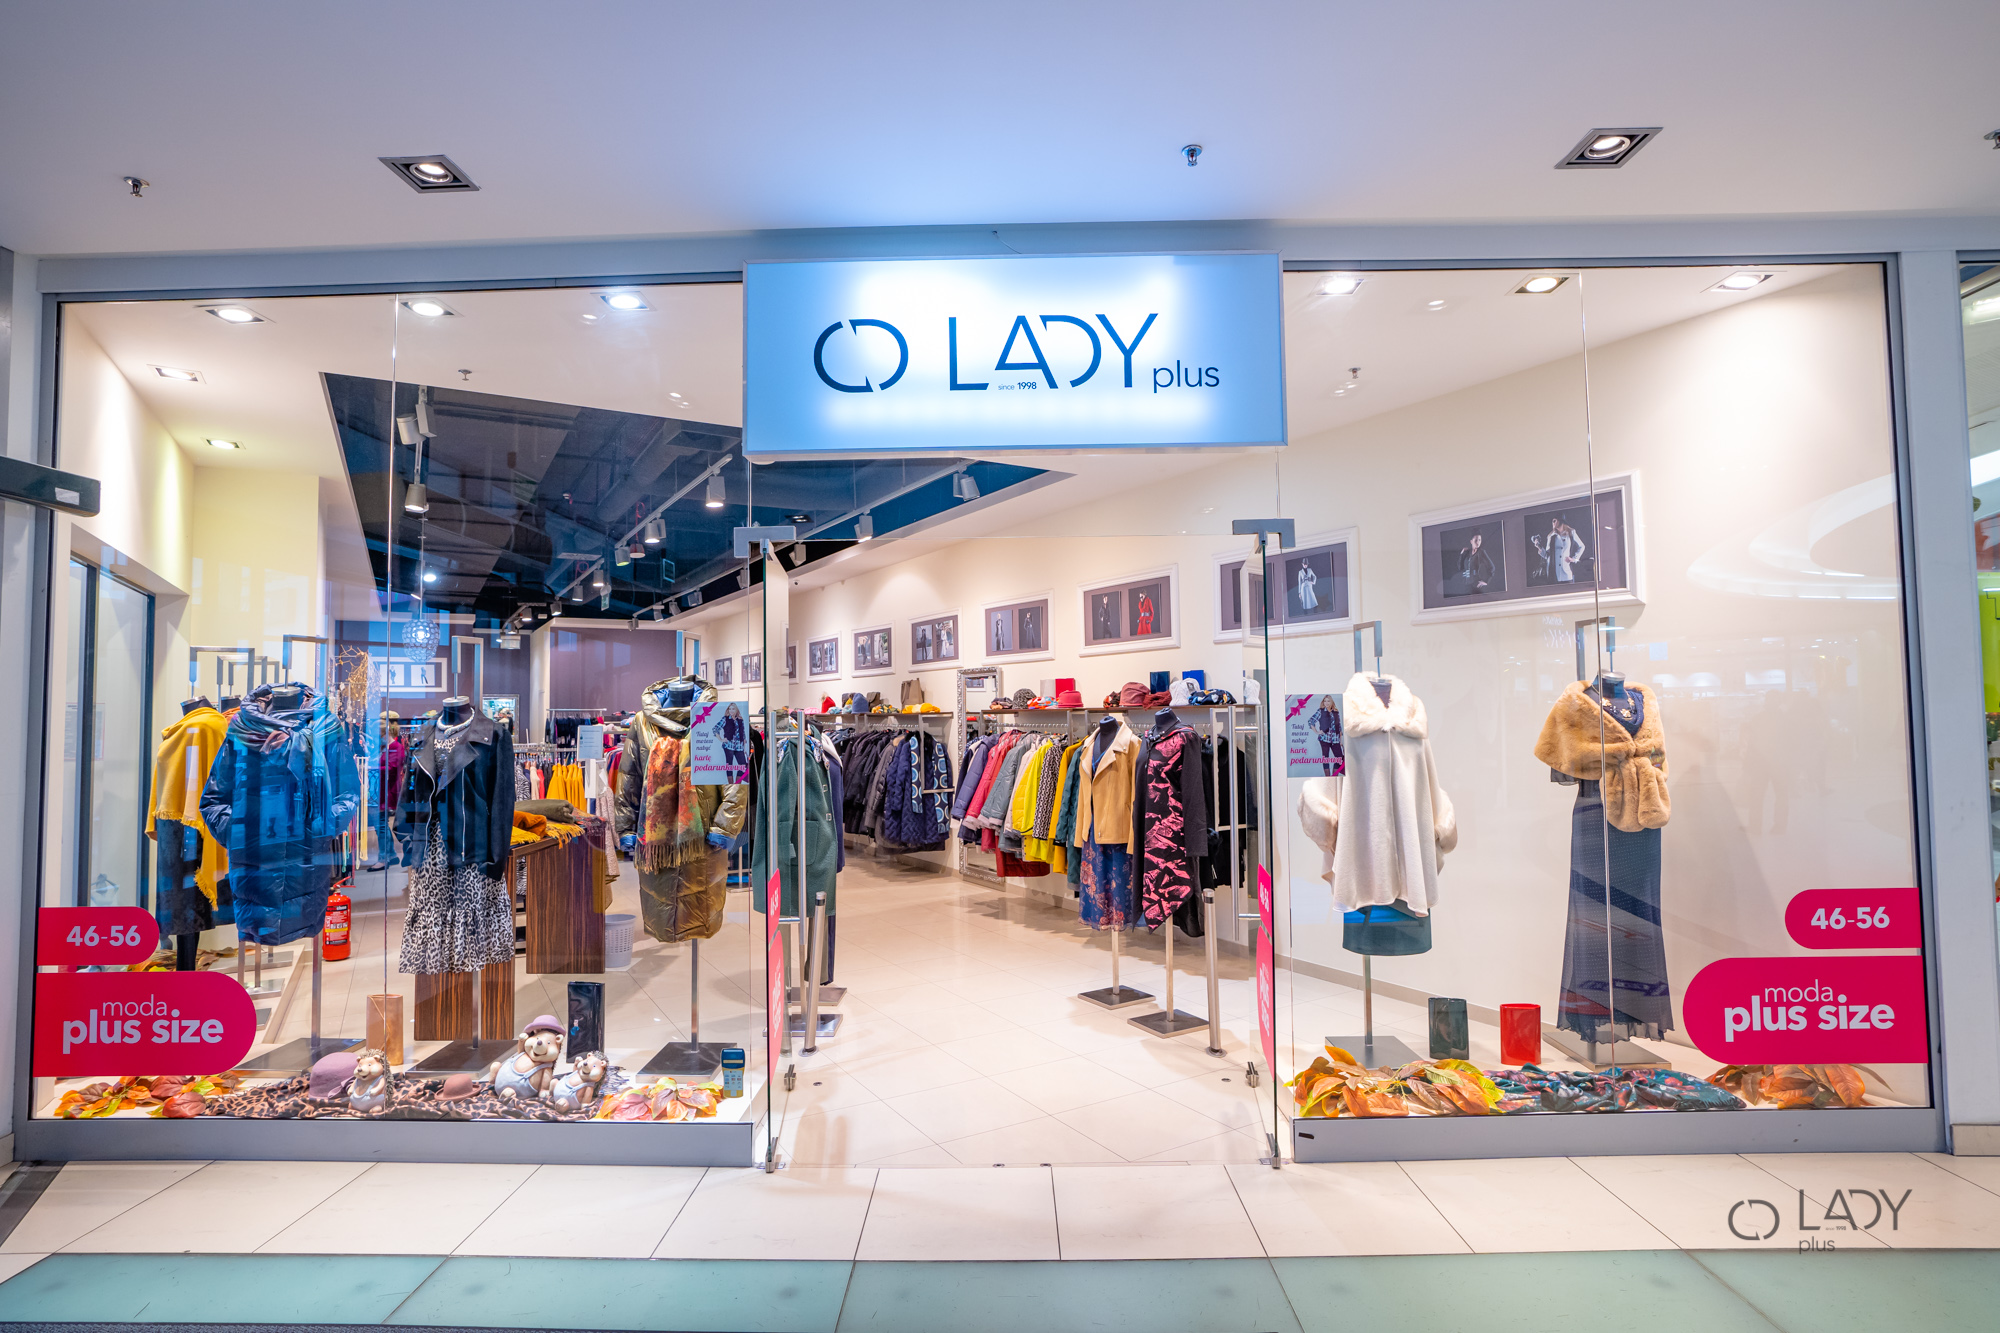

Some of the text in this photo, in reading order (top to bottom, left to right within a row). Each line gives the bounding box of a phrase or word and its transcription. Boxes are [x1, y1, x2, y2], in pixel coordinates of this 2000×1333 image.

[948, 313, 1159, 391] LADY
[1153, 360, 1220, 393] plus
[1017, 381, 1037, 390] 1998
[1811, 906, 1890, 929] 46-56
[66, 925, 141, 947] 46-56
[1764, 979, 1833, 1002] moda
[102, 994, 167, 1016] moda
[1724, 994, 1895, 1042] plus size
[62, 1009, 224, 1054] plus size
